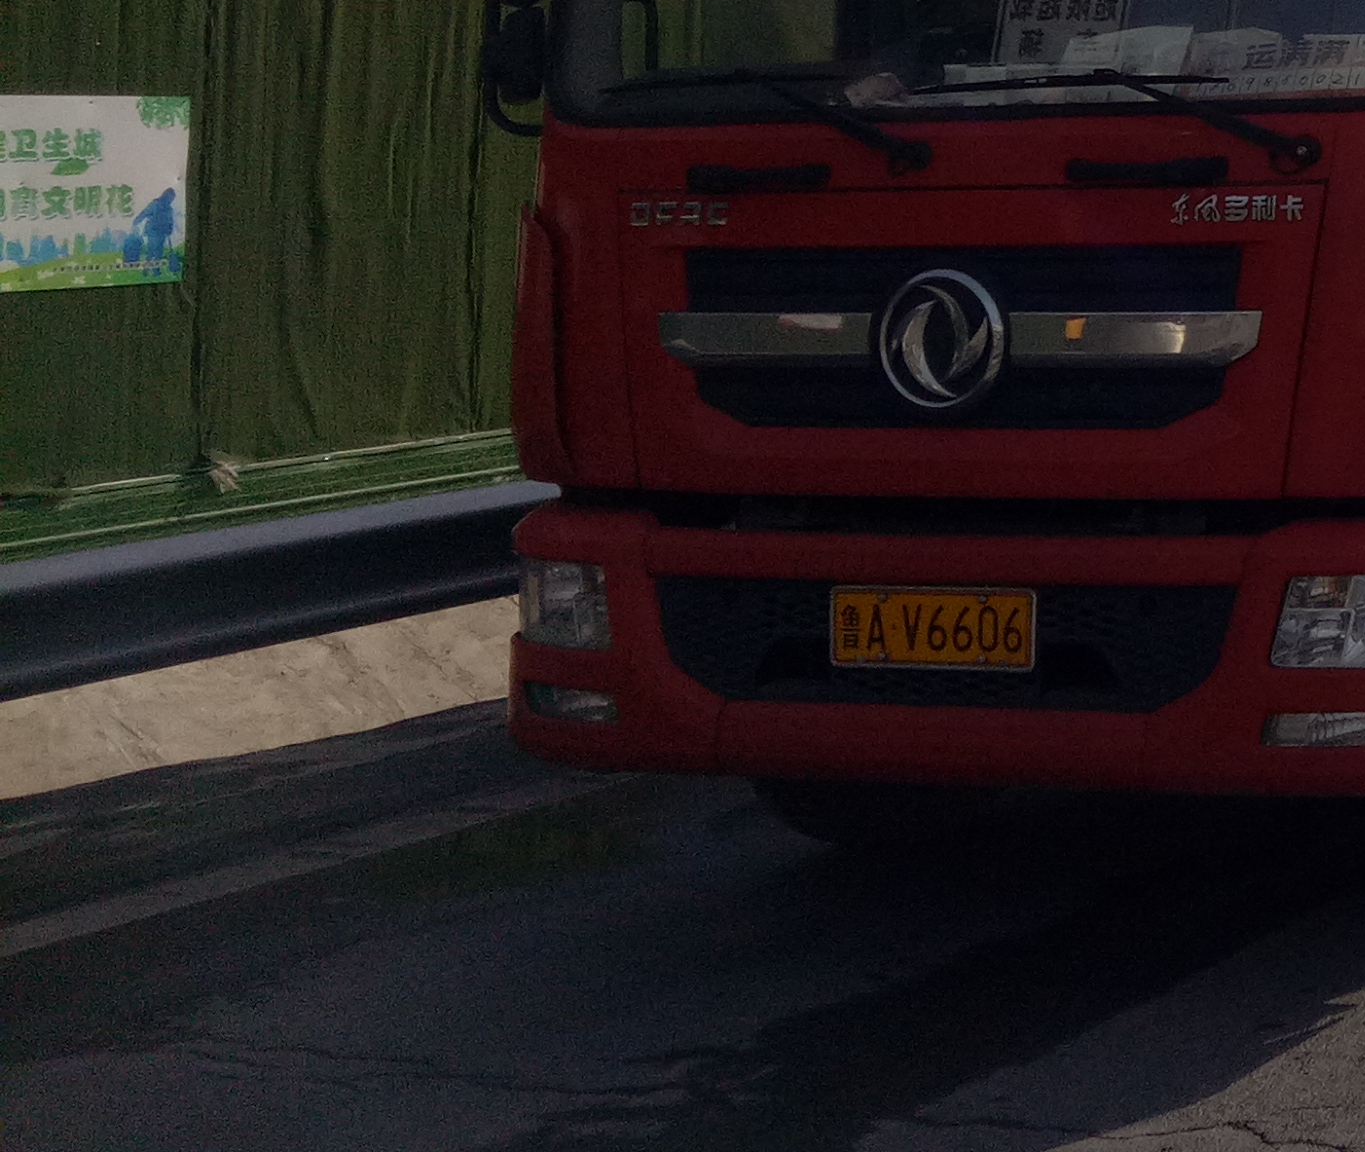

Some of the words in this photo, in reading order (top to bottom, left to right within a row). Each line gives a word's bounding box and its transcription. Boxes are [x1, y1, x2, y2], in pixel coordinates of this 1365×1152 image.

[0, 127, 103, 160] 卫生城
[1169, 192, 1305, 226] 东风多利卡
